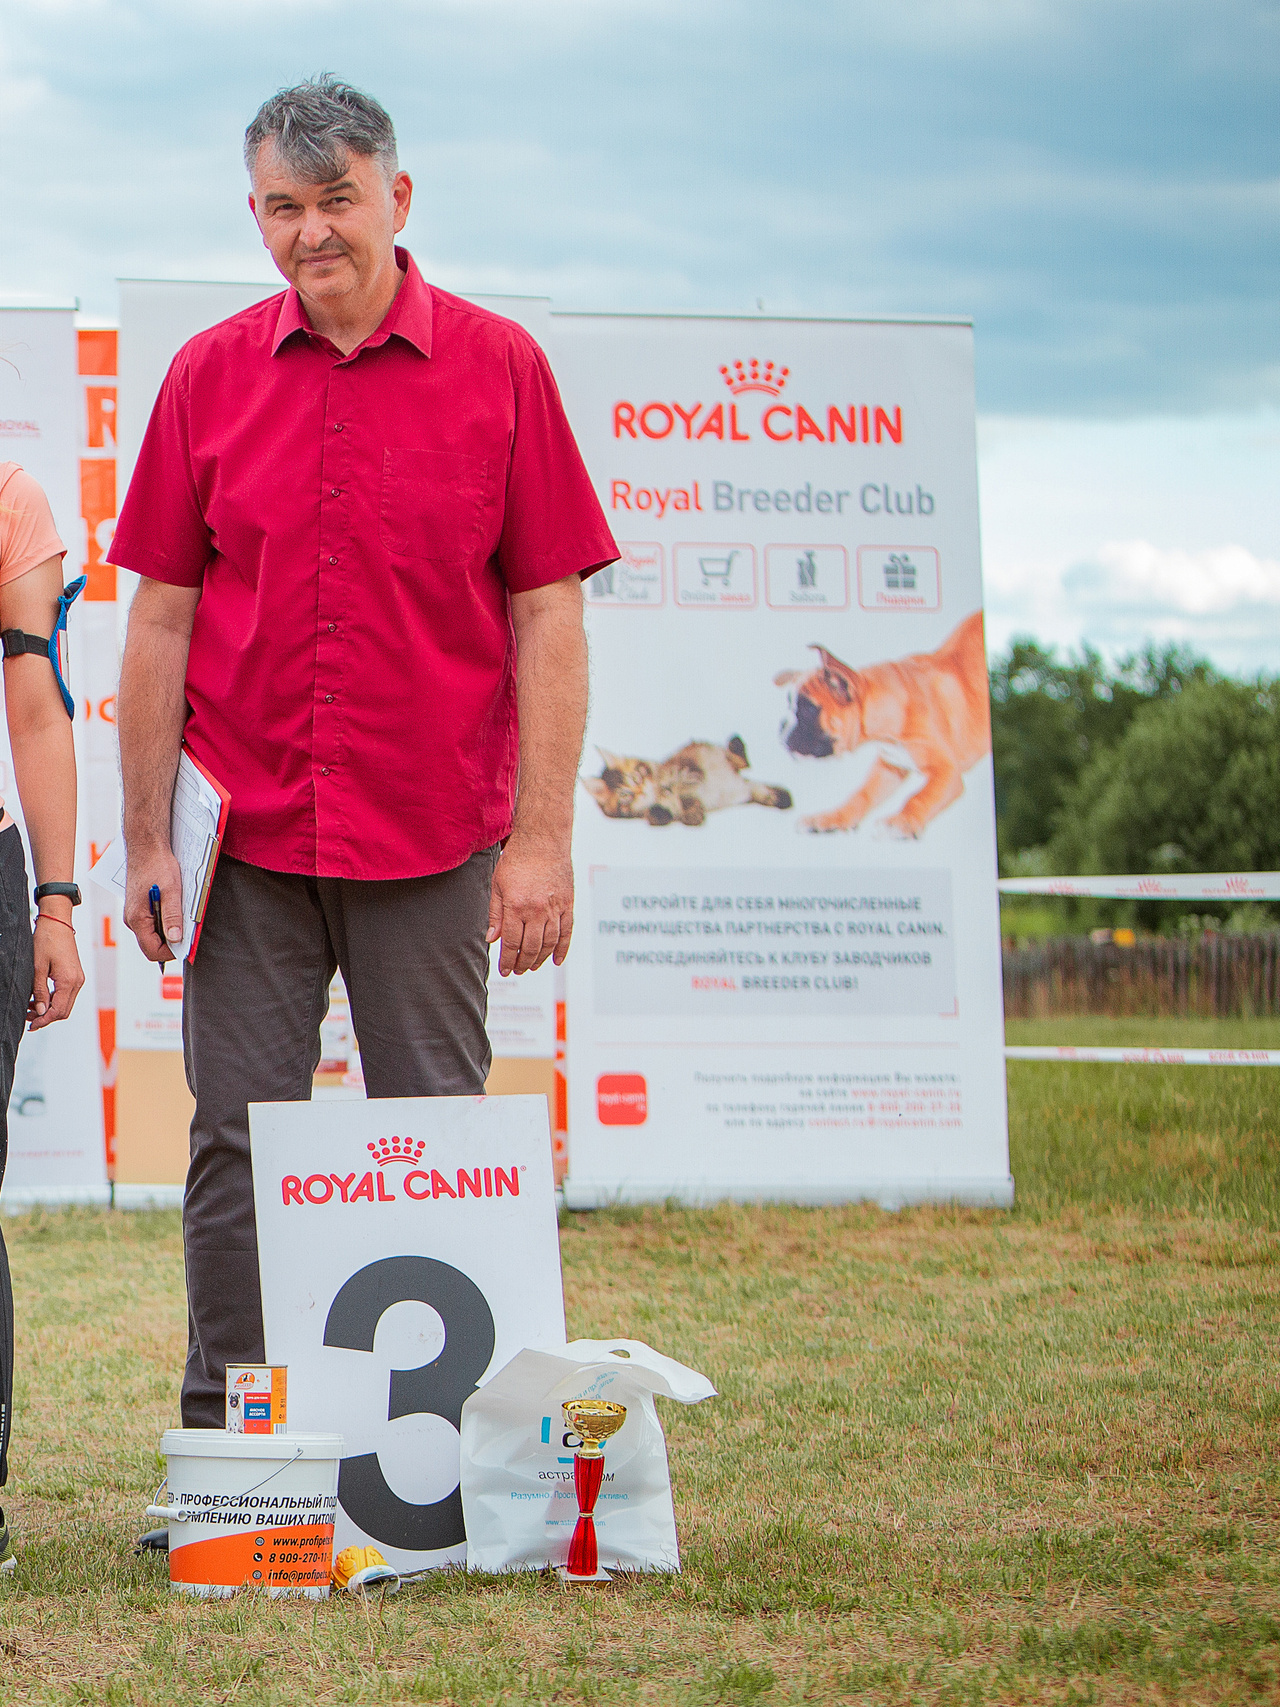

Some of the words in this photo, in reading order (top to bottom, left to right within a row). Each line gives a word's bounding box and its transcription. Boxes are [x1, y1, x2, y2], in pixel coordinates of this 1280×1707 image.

[613, 402, 749, 440] ROYAL
[762, 404, 903, 444] CANIN
[610, 480, 704, 518] Royal
[712, 481, 851, 515] Breeder
[859, 482, 935, 516] Club
[622, 894, 698, 910] ОТКРОЙТЕ
[702, 896, 733, 911] ДЛЯ
[736, 896, 775, 910] СЕБЯ
[777, 896, 921, 911] МНОГОЧИСЛЕННЫЕ
[599, 921, 723, 936] ПРЕИМУЩЕСТВА
[725, 921, 831, 936] ПАРТНЕРСТВА
[834, 922, 843, 935] С
[847, 921, 893, 936] ROYAL
[616, 949, 764, 967] ПРИСОЕДИНЯЙТЕСЬ
[768, 951, 778, 965] К
[782, 951, 827, 965] КЛУБУ
[833, 951, 932, 968] ЗАВОДЧИКОВ
[691, 976, 738, 990] ROYAL
[742, 975, 811, 990] BREEDER
[814, 975, 859, 990] CLUB!
[281, 1171, 396, 1206] ROYAL
[323, 1255, 496, 1551] 3
[180, 1492, 322, 1509] ПРОФЕССИОНАЛЬНЫЙ
[256, 1513, 305, 1526] ВАШИХ
[269, 1552, 276, 1563] 8
